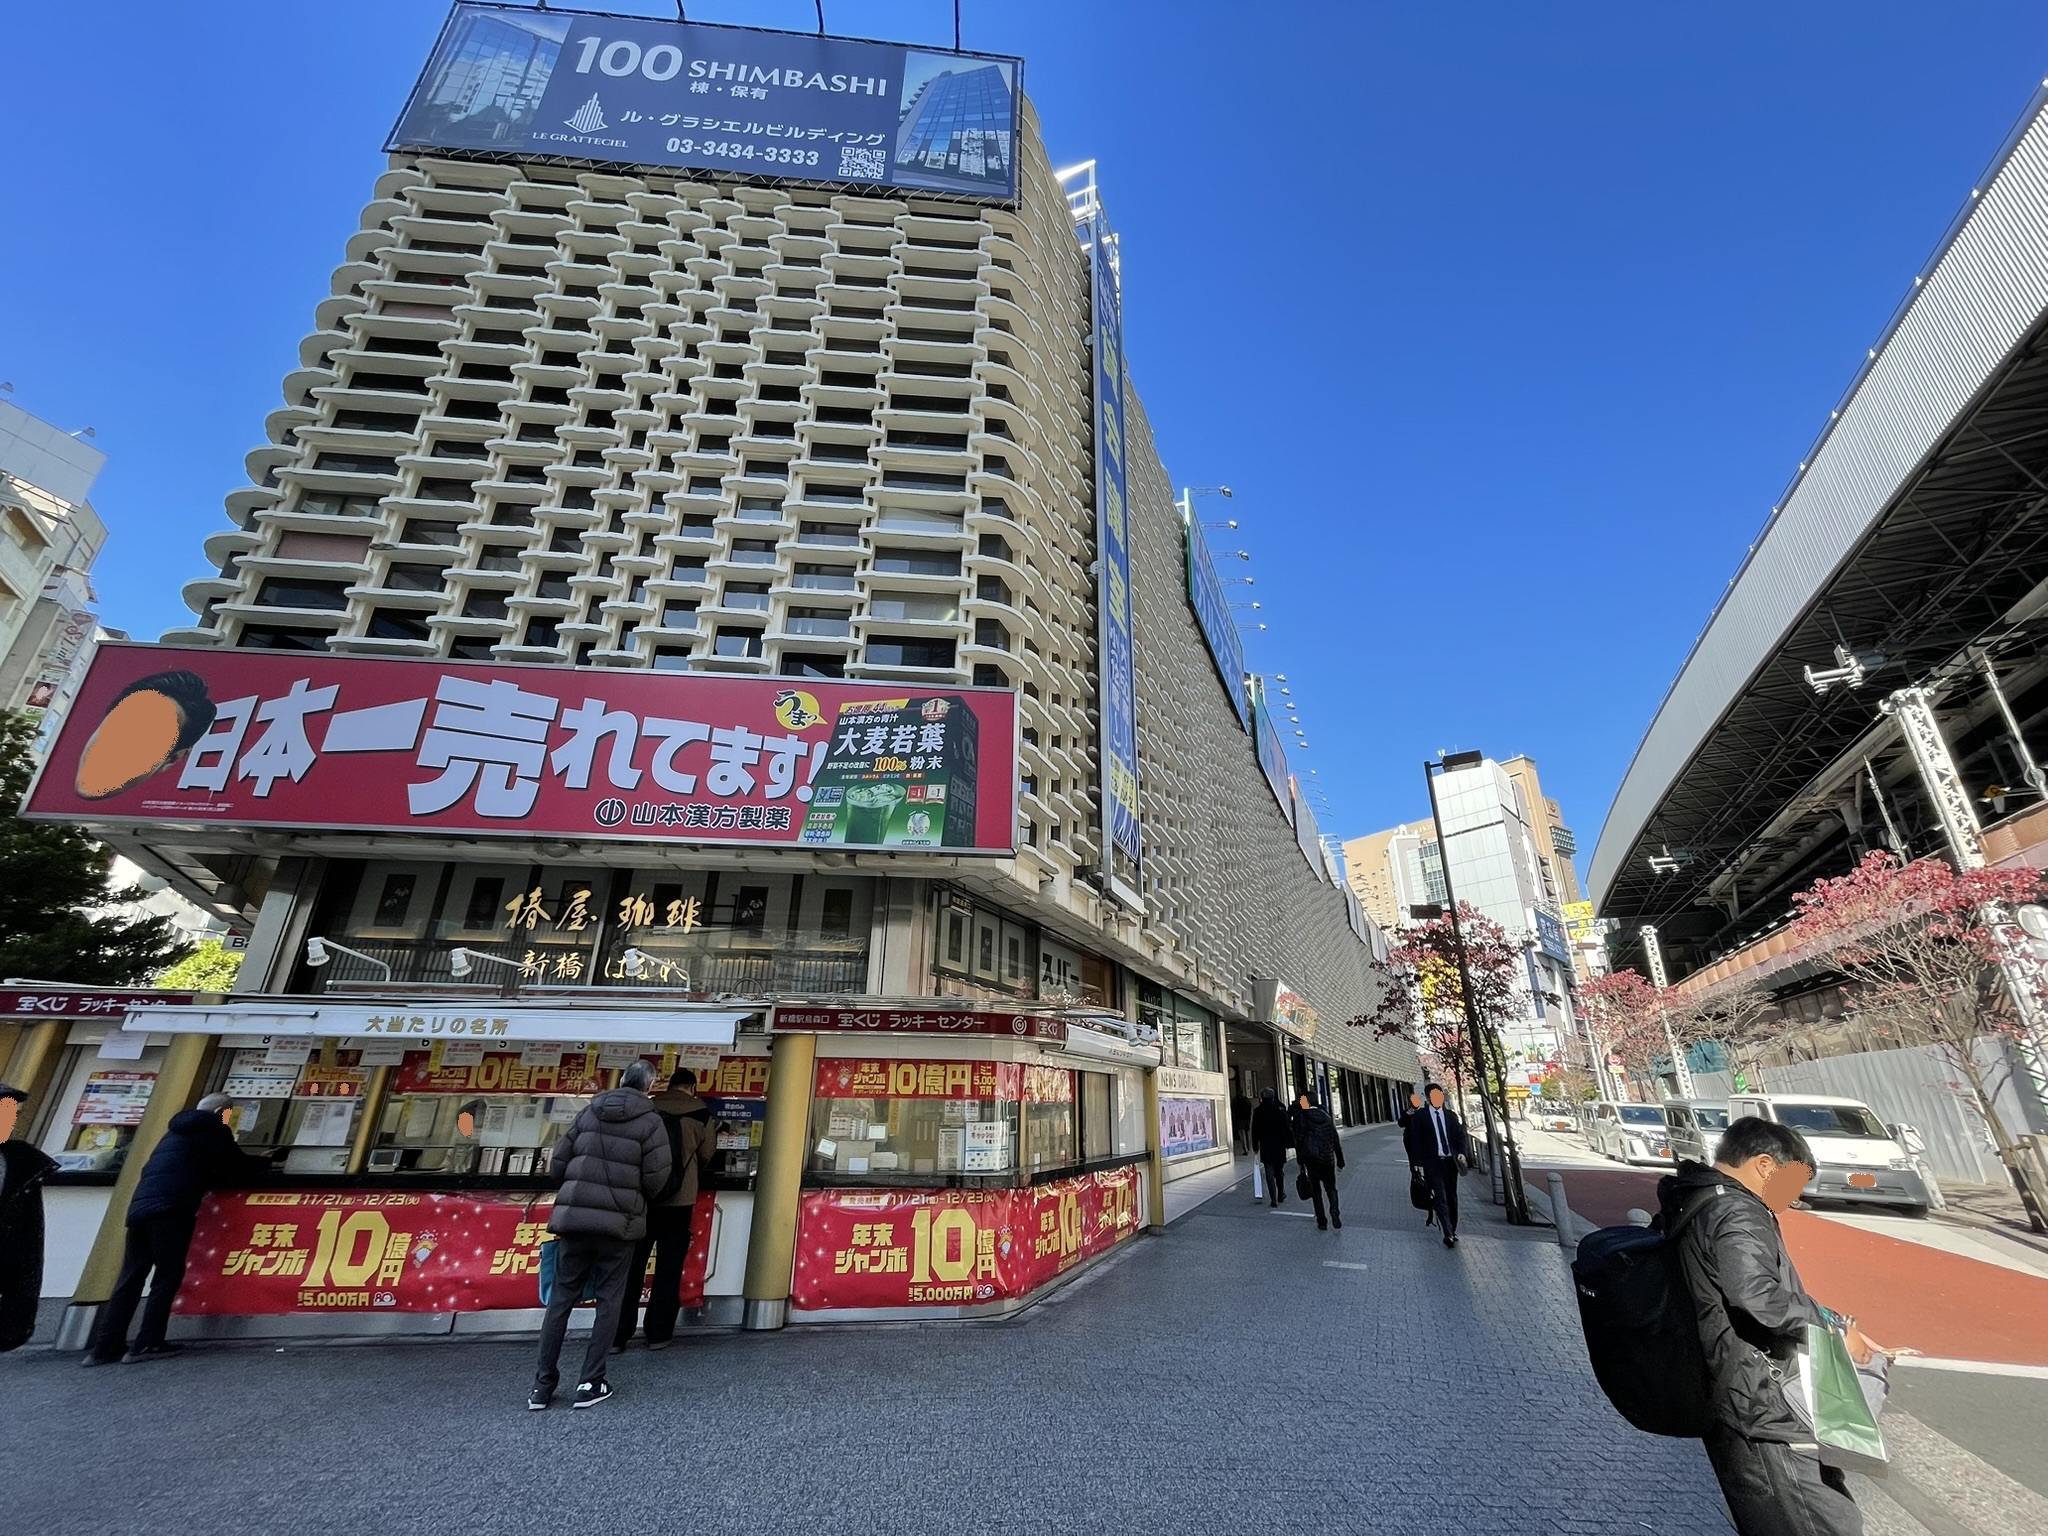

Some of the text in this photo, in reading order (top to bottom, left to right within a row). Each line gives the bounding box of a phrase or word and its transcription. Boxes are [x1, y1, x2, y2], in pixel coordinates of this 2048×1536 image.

[575, 36, 888, 98] 100 SHIMBASHI
[689, 81, 768, 101] 棟・保有
[532, 132, 548, 140] LE
[621, 108, 886, 147] ル・グラシエルビルディング
[666, 136, 820, 166] 03-3434-3333
[833, 722, 947, 756] 大麦若葉
[909, 755, 944, 770] 粉末
[632, 801, 792, 831] 山本漢方製薬
[15, 996, 69, 1012] 宝くじ
[365, 1015, 509, 1035] 大当たりの名所
[838, 1013, 881, 1027] 宝くじ
[889, 1012, 985, 1030] ラッキーセンター
[1038, 1020, 1058, 1036] 宝くじ
[854, 1073, 886, 1084] ジャンボ
[861, 1063, 880, 1073] 年末
[887, 1063, 973, 1096] 10億円
[1040, 1209, 1056, 1232] 年末
[248, 1223, 298, 1248] 年末
[851, 1223, 894, 1247] 年末
[1035, 1229, 1060, 1260] ジャンボ
[221, 1248, 309, 1276] ジャンボ
[834, 1246, 908, 1275] ジャンボ
